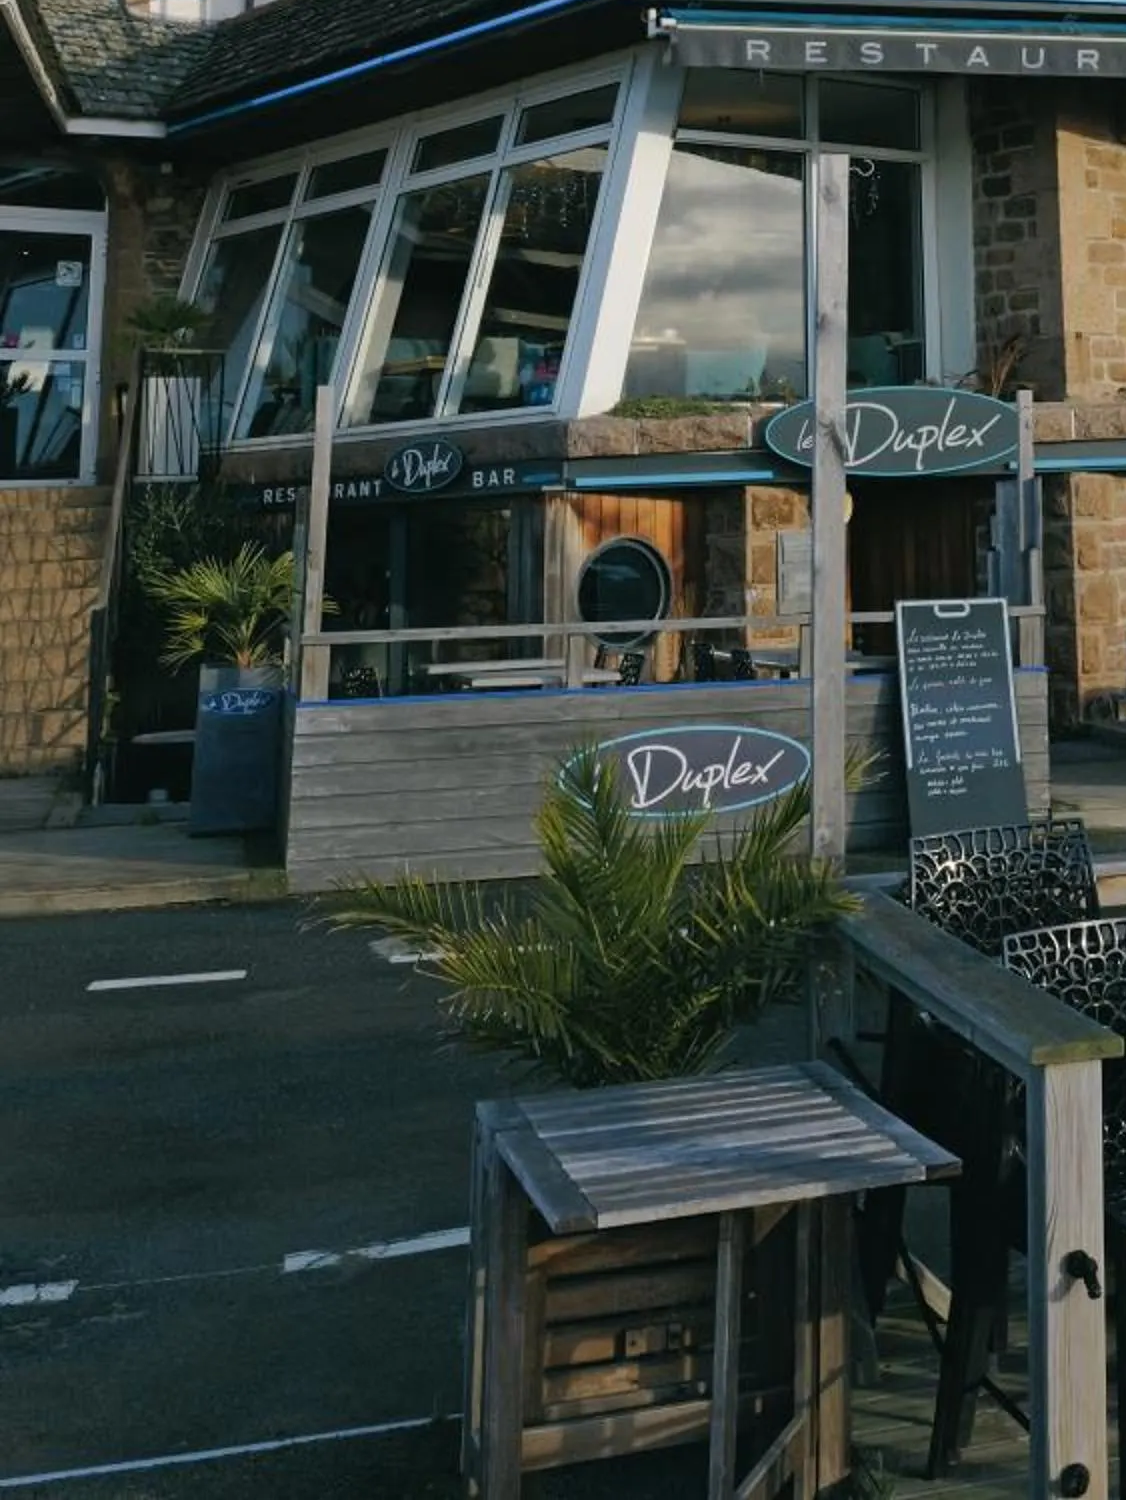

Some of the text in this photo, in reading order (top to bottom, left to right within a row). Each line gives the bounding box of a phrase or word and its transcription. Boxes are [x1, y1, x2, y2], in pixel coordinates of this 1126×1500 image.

[843, 397, 1001, 470] Duplex
[263, 479, 382, 505] RESRANT
[472, 467, 516, 488] BAR
[627, 735, 785, 809] Duplex
